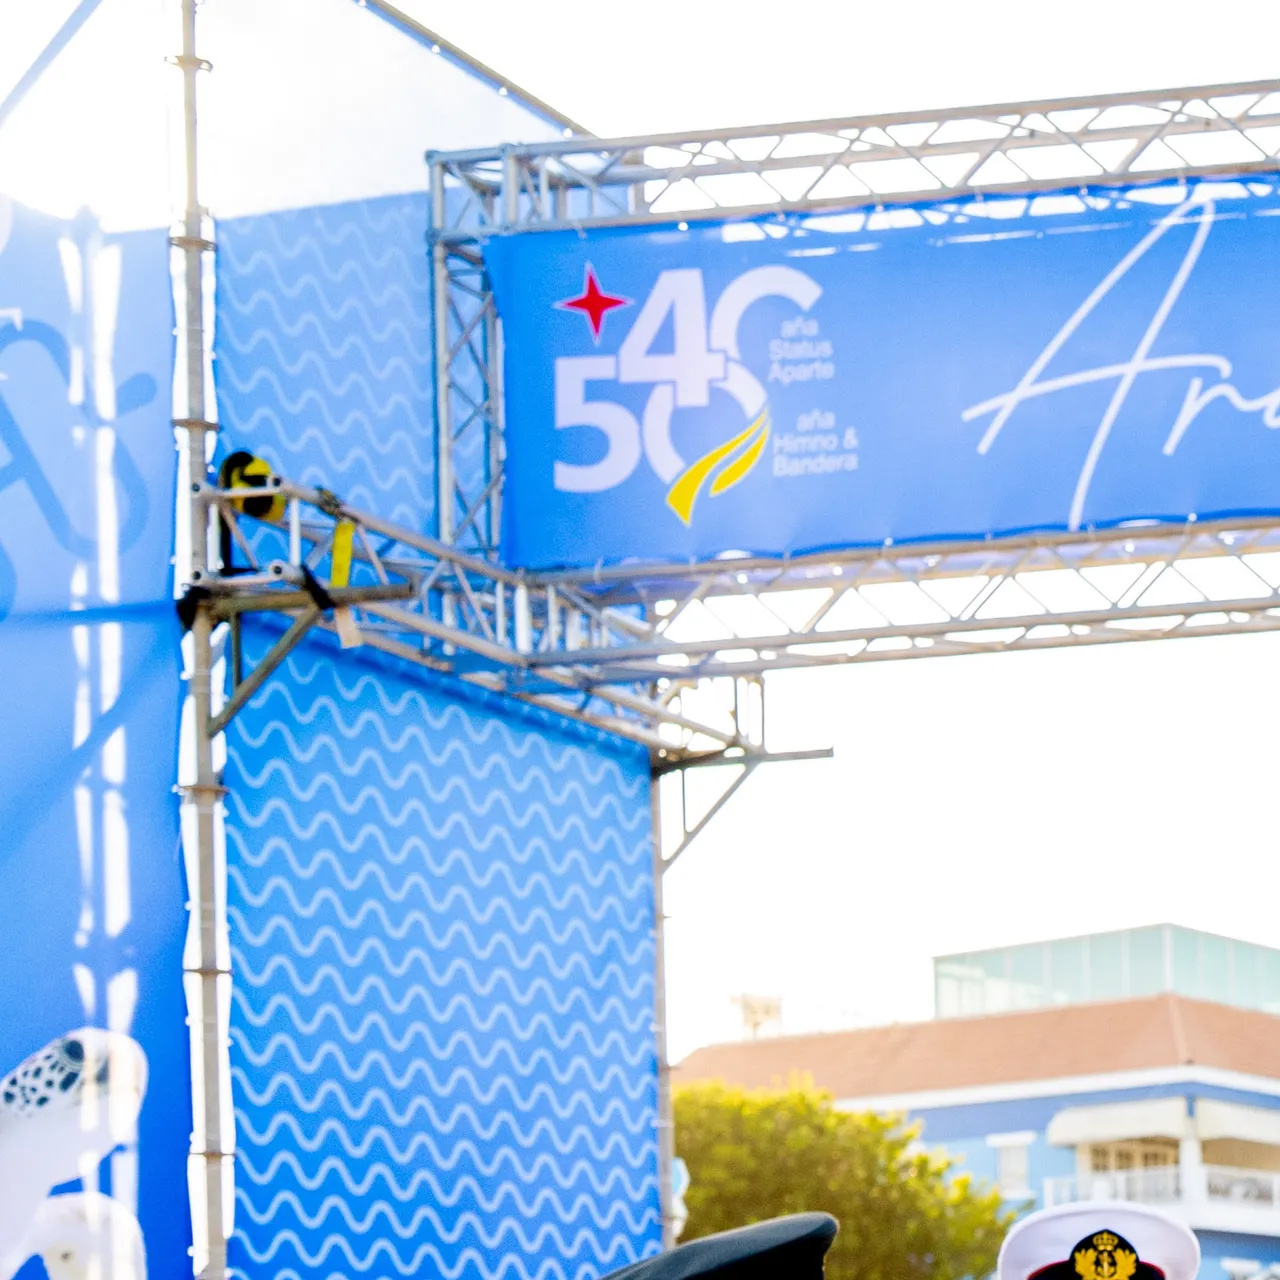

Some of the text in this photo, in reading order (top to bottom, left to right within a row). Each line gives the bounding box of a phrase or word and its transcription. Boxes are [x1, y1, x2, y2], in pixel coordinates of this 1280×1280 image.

[769, 338, 834, 361] Status
[767, 360, 836, 387] Aparte
[773, 426, 858, 455] Himno &
[772, 453, 859, 478] Bandera
